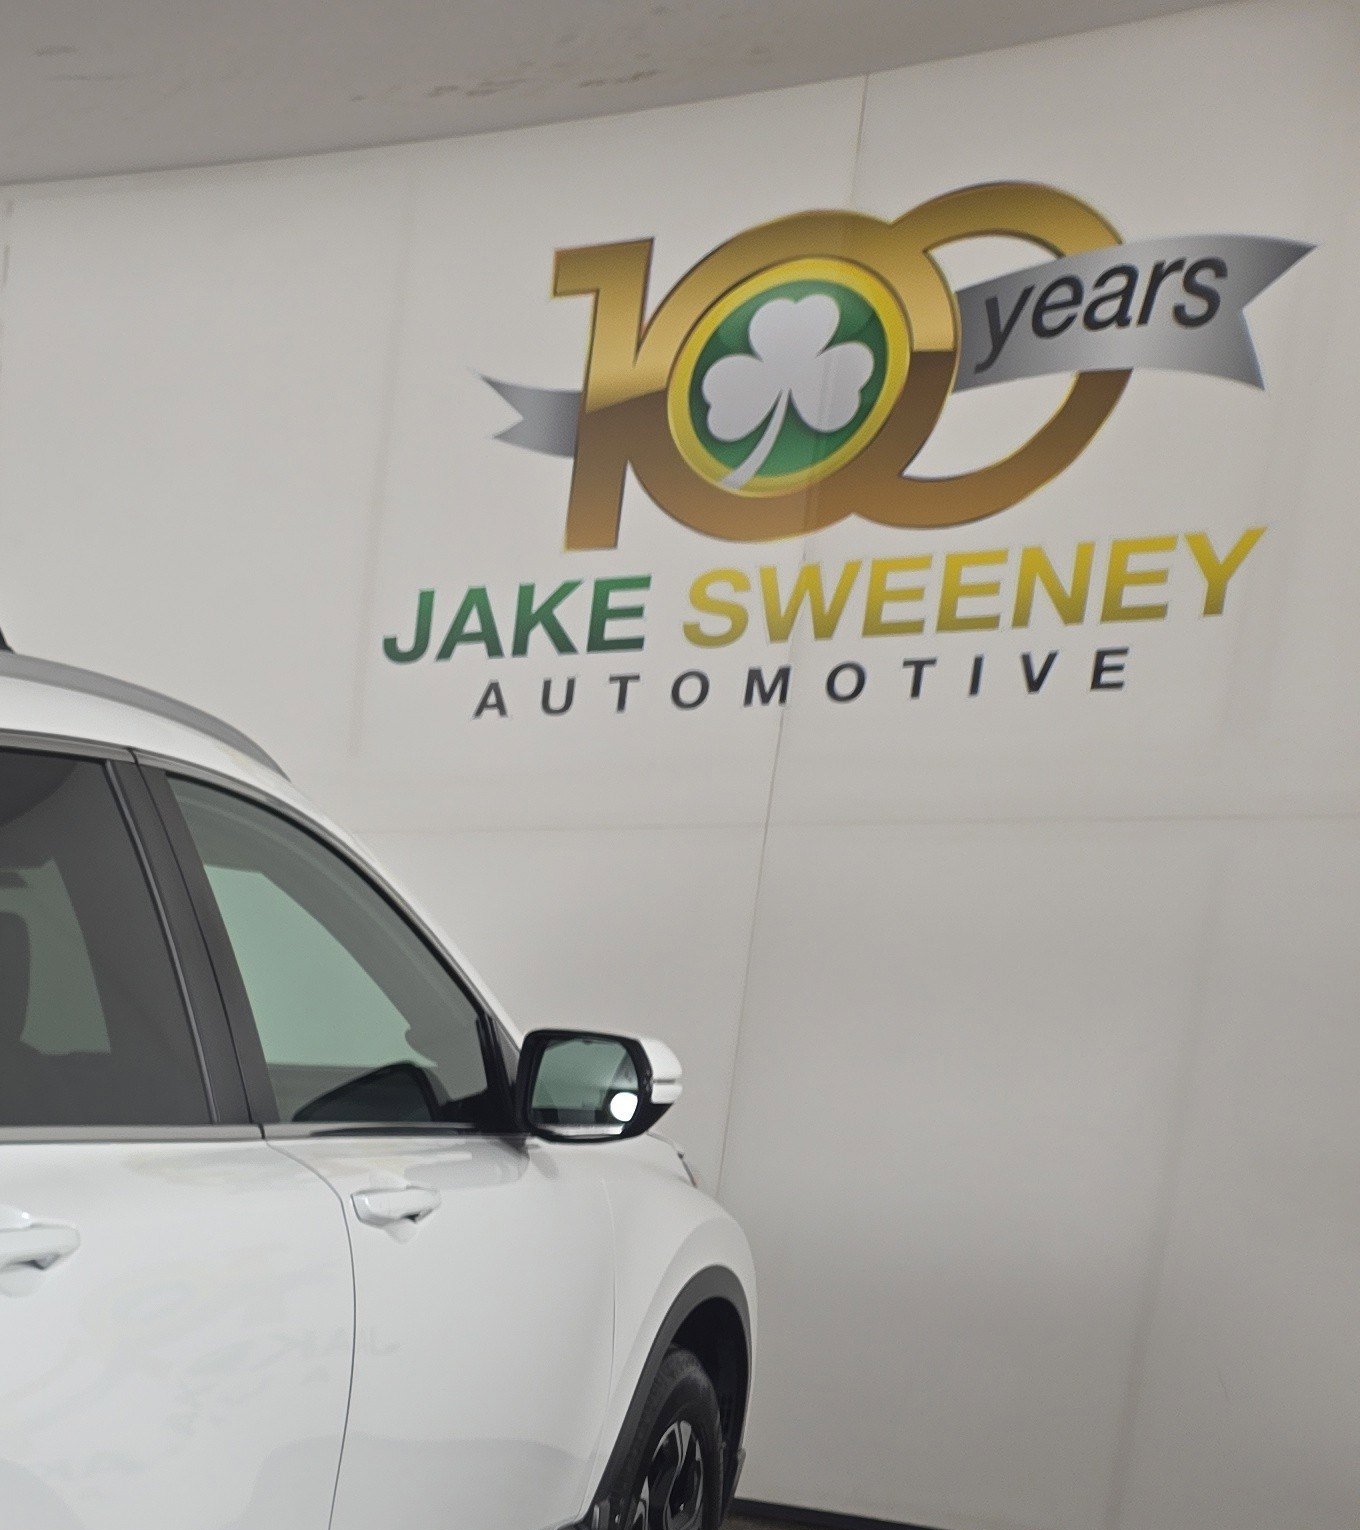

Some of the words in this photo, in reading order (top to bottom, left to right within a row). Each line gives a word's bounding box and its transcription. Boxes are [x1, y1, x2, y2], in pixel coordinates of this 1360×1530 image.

[973, 255, 1229, 375] years
[381, 574, 653, 665] JAKE
[680, 525, 1269, 650] SWEENEY
[472, 647, 1131, 721] AUTOMOTIVE
